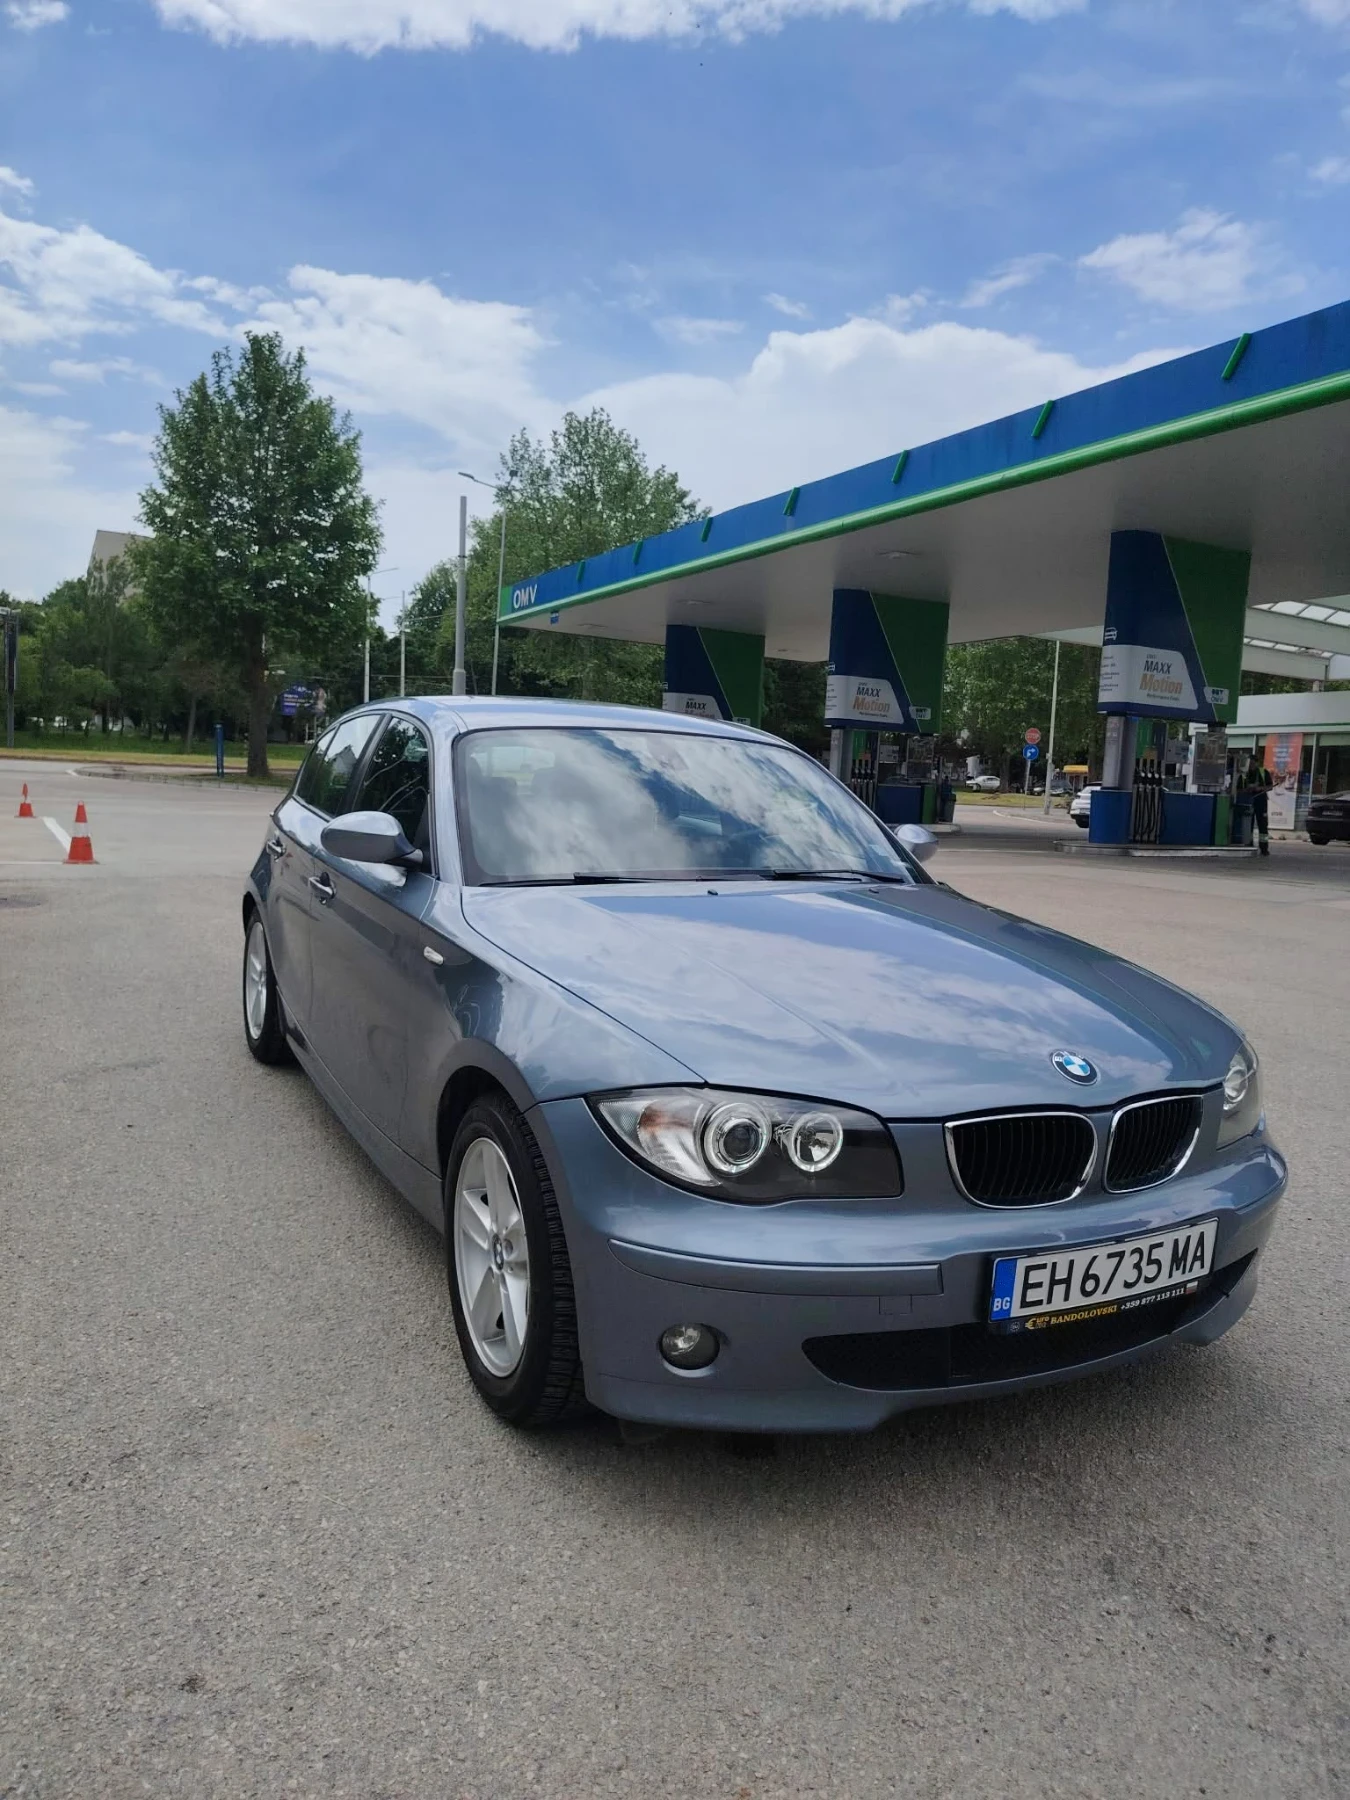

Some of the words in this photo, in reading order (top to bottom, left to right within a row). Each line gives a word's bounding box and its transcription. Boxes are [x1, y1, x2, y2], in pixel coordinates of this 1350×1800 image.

[513, 584, 538, 608] OMV
[1143, 660, 1172, 674] MAXX
[856, 686, 881, 698] MAXX
[1139, 673, 1183, 694] Motion
[685, 701, 707, 711] MAXX
[852, 696, 891, 713] Motion
[1020, 1258, 1075, 1309] EH
[1080, 1241, 1165, 1298] 6735
[1168, 1231, 1205, 1279] MA
[993, 1297, 1011, 1312] BG
[1050, 1306, 1117, 1325] BANDOLOVSKI
[1120, 1300, 1140, 1310] +359
[1141, 1295, 1156, 1305] 877
